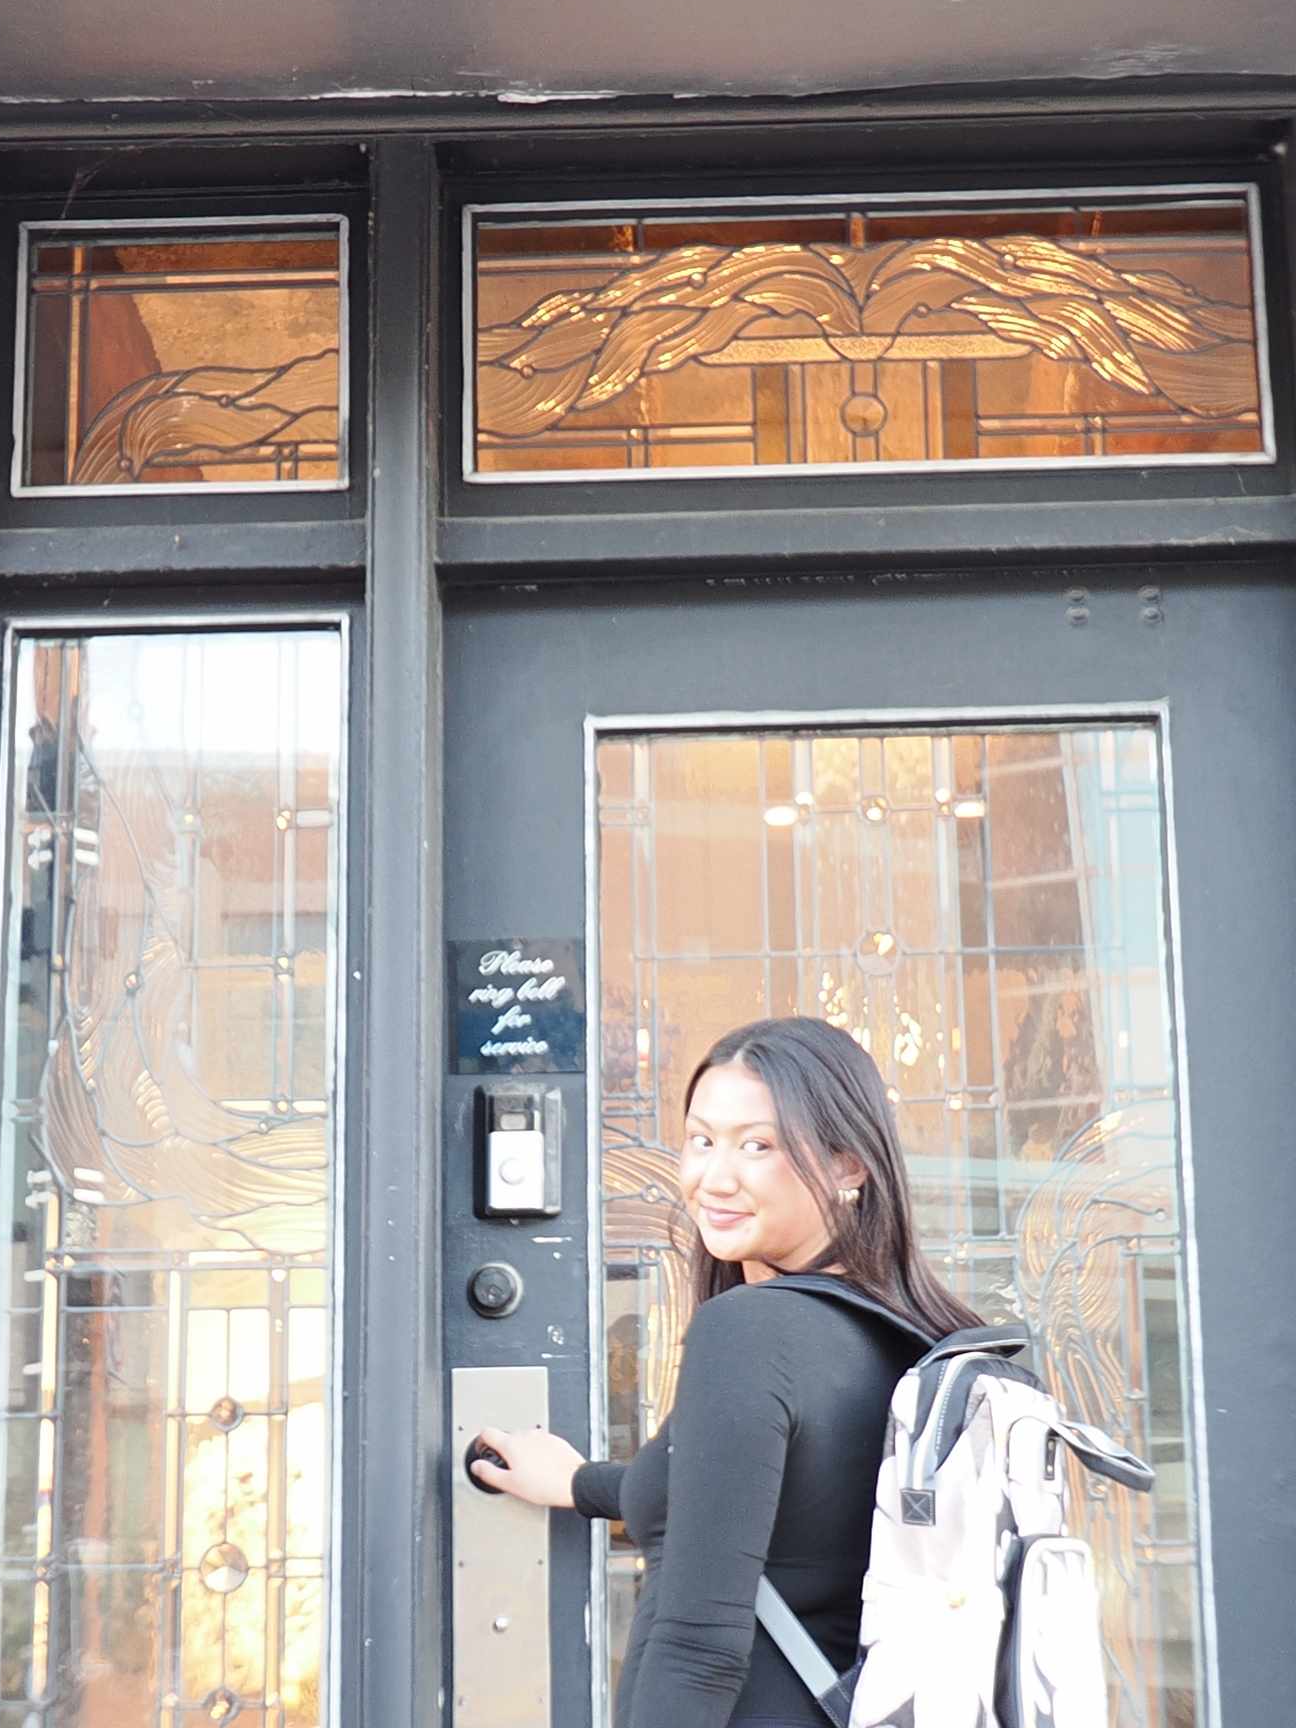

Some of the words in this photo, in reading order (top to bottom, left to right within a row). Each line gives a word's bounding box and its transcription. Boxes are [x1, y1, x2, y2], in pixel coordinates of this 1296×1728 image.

[478, 950, 554, 975] Please
[468, 983, 514, 1008] ring
[517, 976, 566, 1001] bell
[491, 1005, 532, 1035] for
[480, 1036, 549, 1056] service
